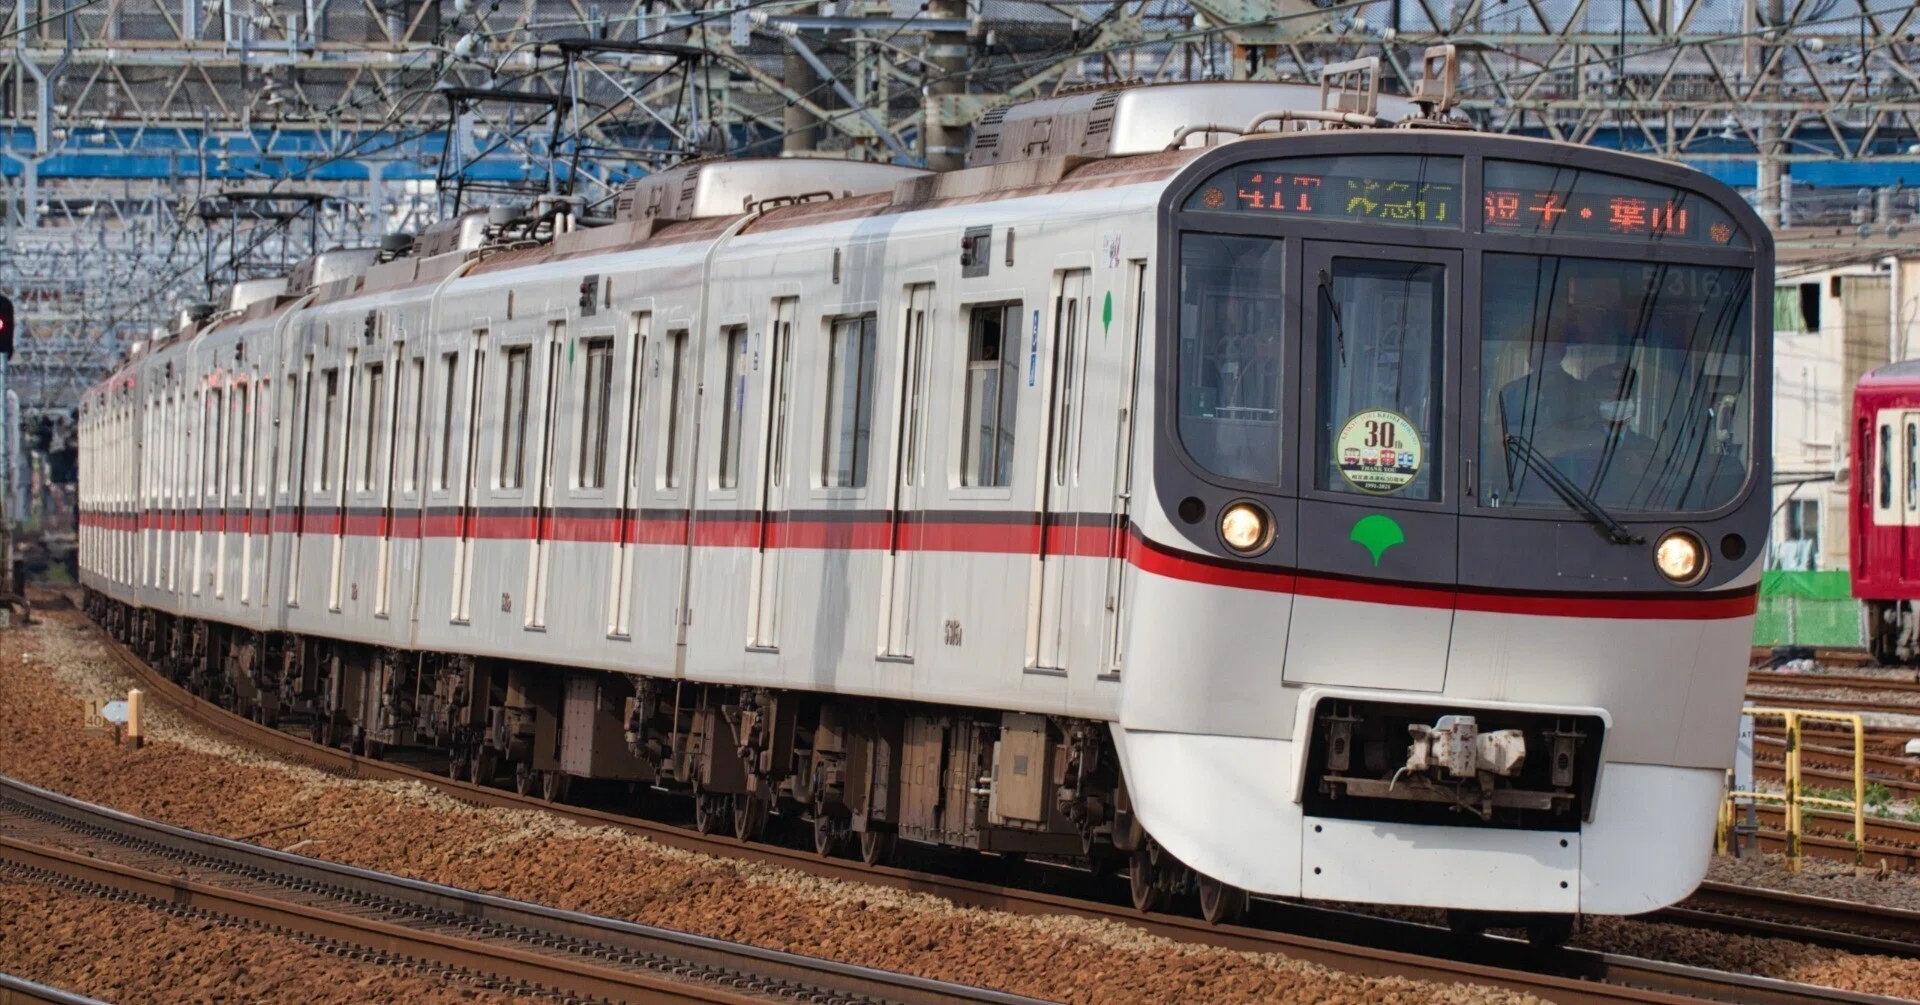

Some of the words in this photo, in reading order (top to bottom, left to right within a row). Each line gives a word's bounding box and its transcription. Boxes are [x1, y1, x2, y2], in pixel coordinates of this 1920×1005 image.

[1238, 173, 1322, 212] 41T
[1364, 419, 1403, 449] 30th
[86, 715, 102, 726] 40
